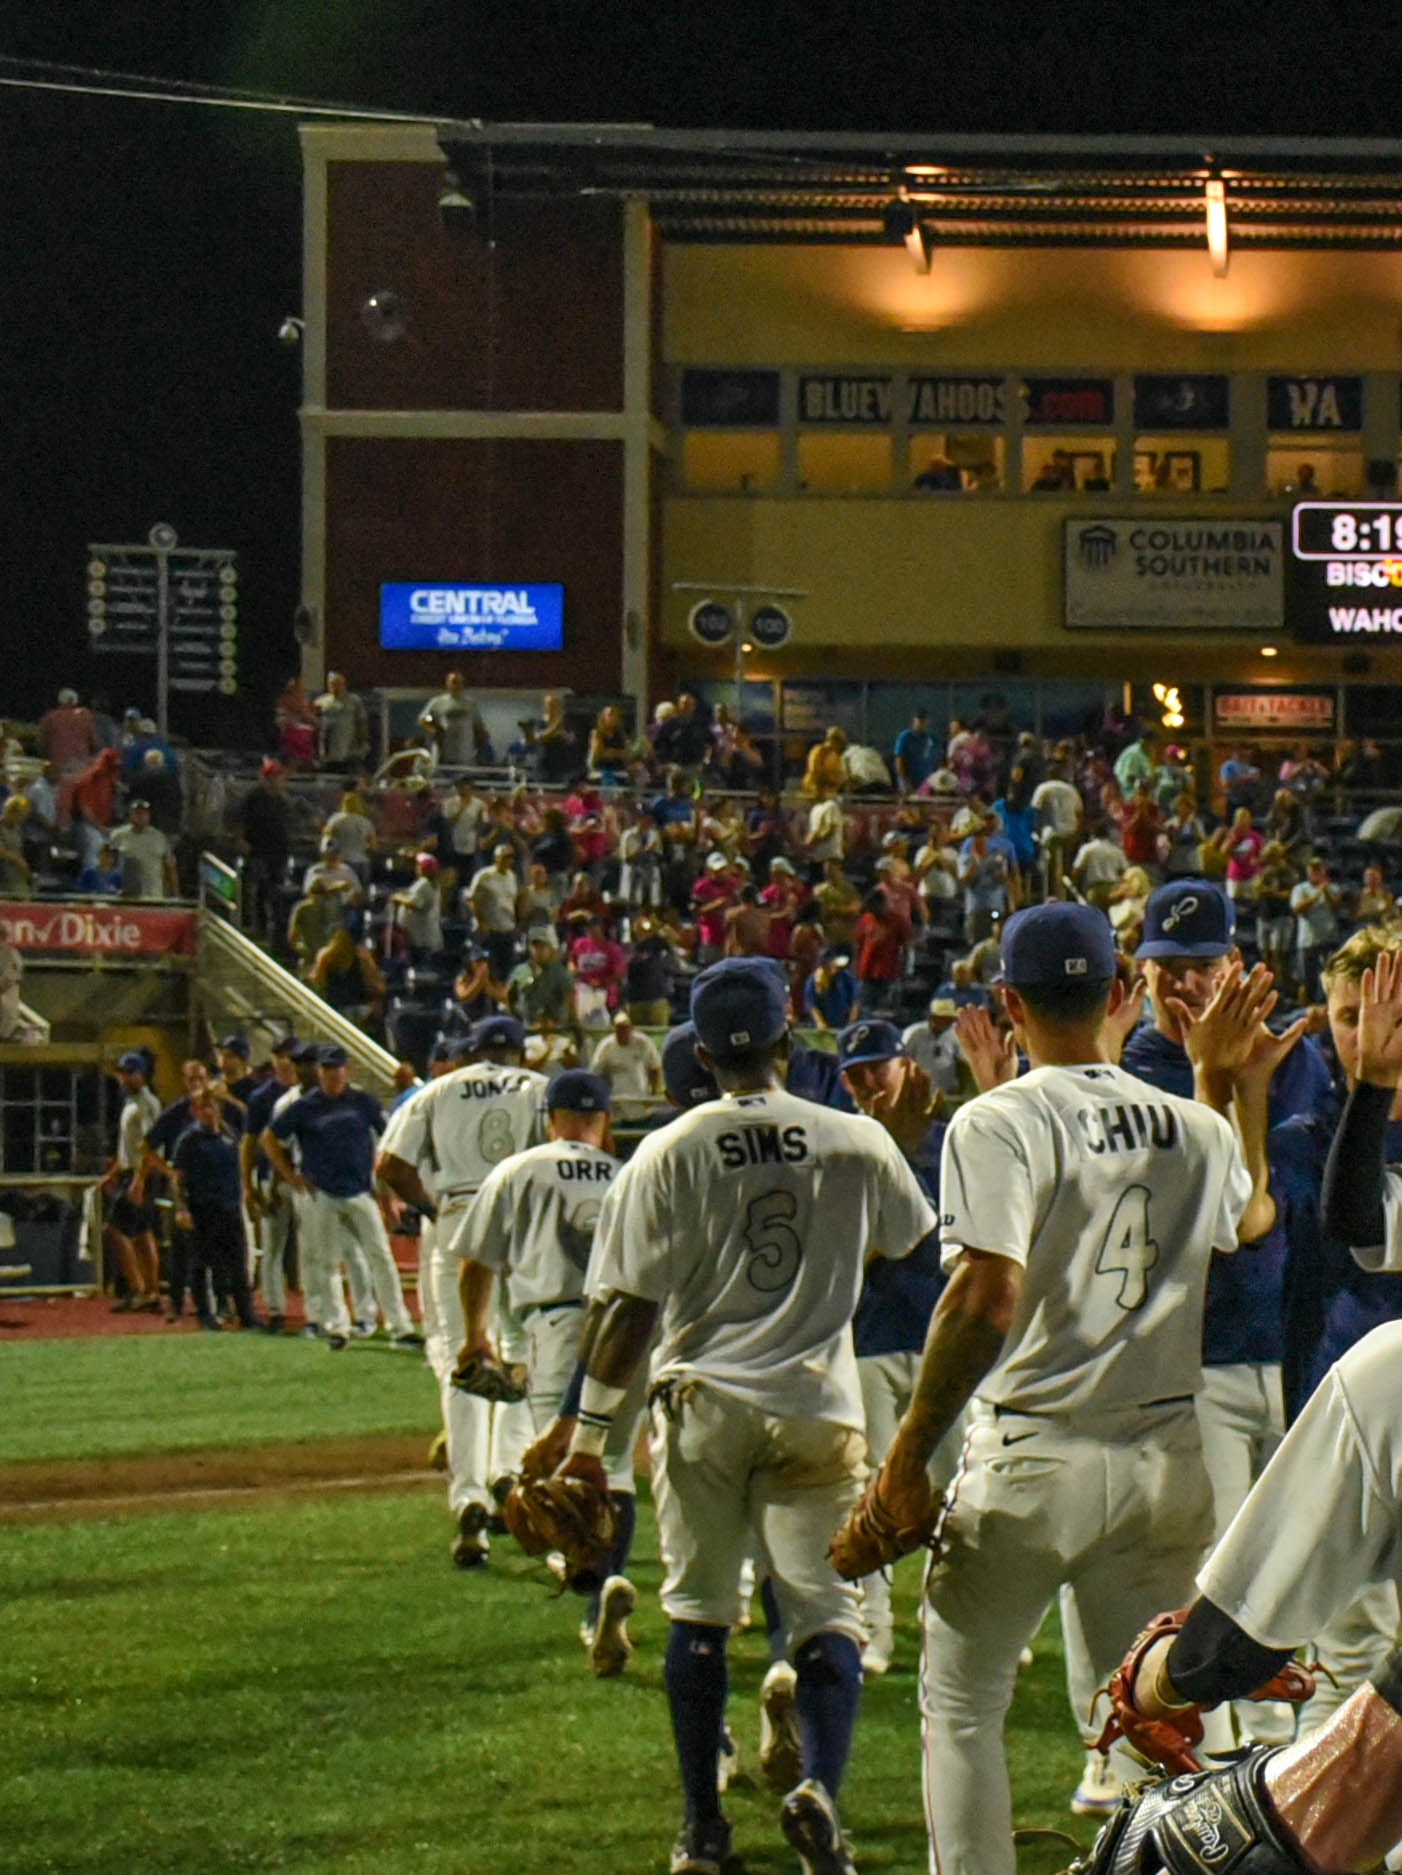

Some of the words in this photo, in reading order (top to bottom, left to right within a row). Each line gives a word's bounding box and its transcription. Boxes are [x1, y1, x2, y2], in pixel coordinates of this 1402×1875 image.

[1129, 529, 1275, 551] COLUMBIA
[1136, 555, 1271, 577] SOUTHERN
[410, 589, 536, 615] CENTRAL
[61, 911, 141, 947] Dixie
[479, 1107, 516, 1165] 8
[716, 1125, 808, 1167] SIMS
[1078, 1104, 1177, 1154] CHIU
[557, 1159, 612, 1182] ORR
[744, 1190, 802, 1293] 5
[1095, 1184, 1160, 1311] 4
